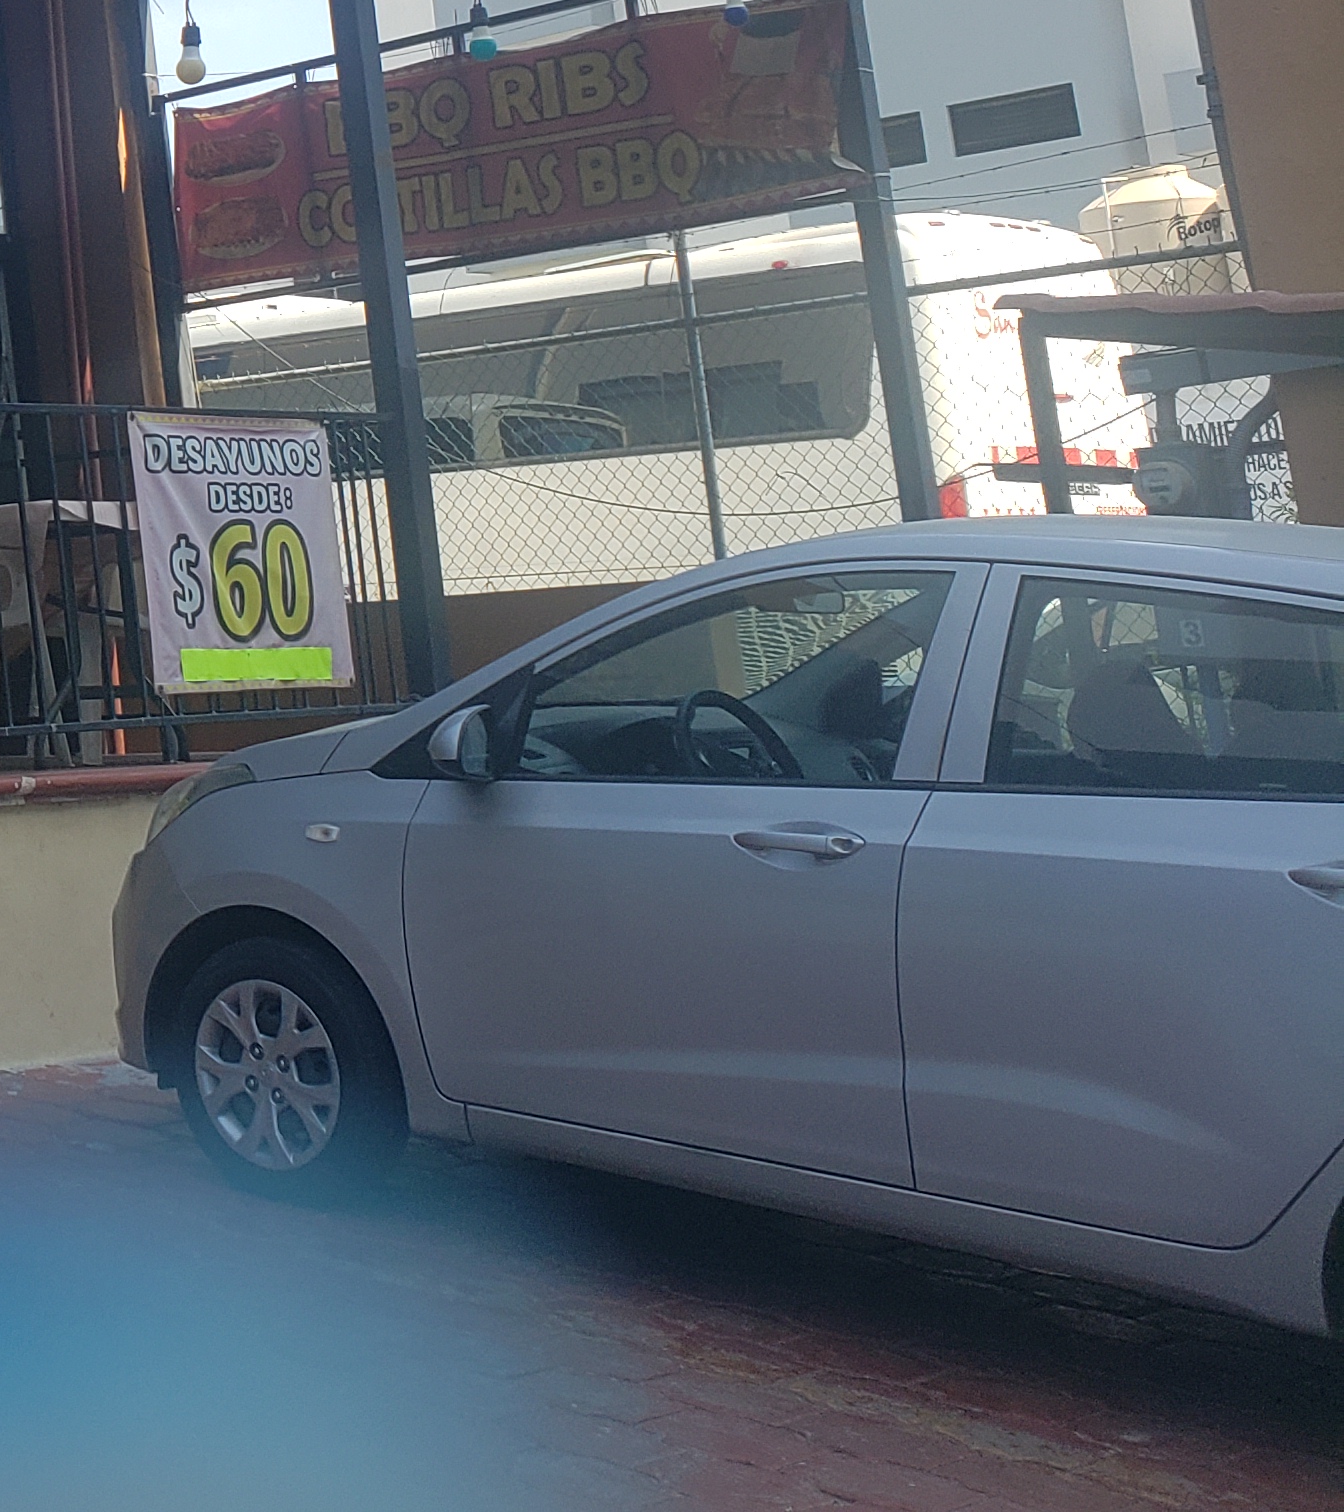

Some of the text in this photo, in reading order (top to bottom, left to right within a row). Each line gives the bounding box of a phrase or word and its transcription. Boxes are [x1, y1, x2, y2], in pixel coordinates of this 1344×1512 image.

[489, 40, 652, 131] RIBS
[298, 130, 708, 248] COTILLAS BBQ
[143, 433, 322, 477] DESAYUNOS
